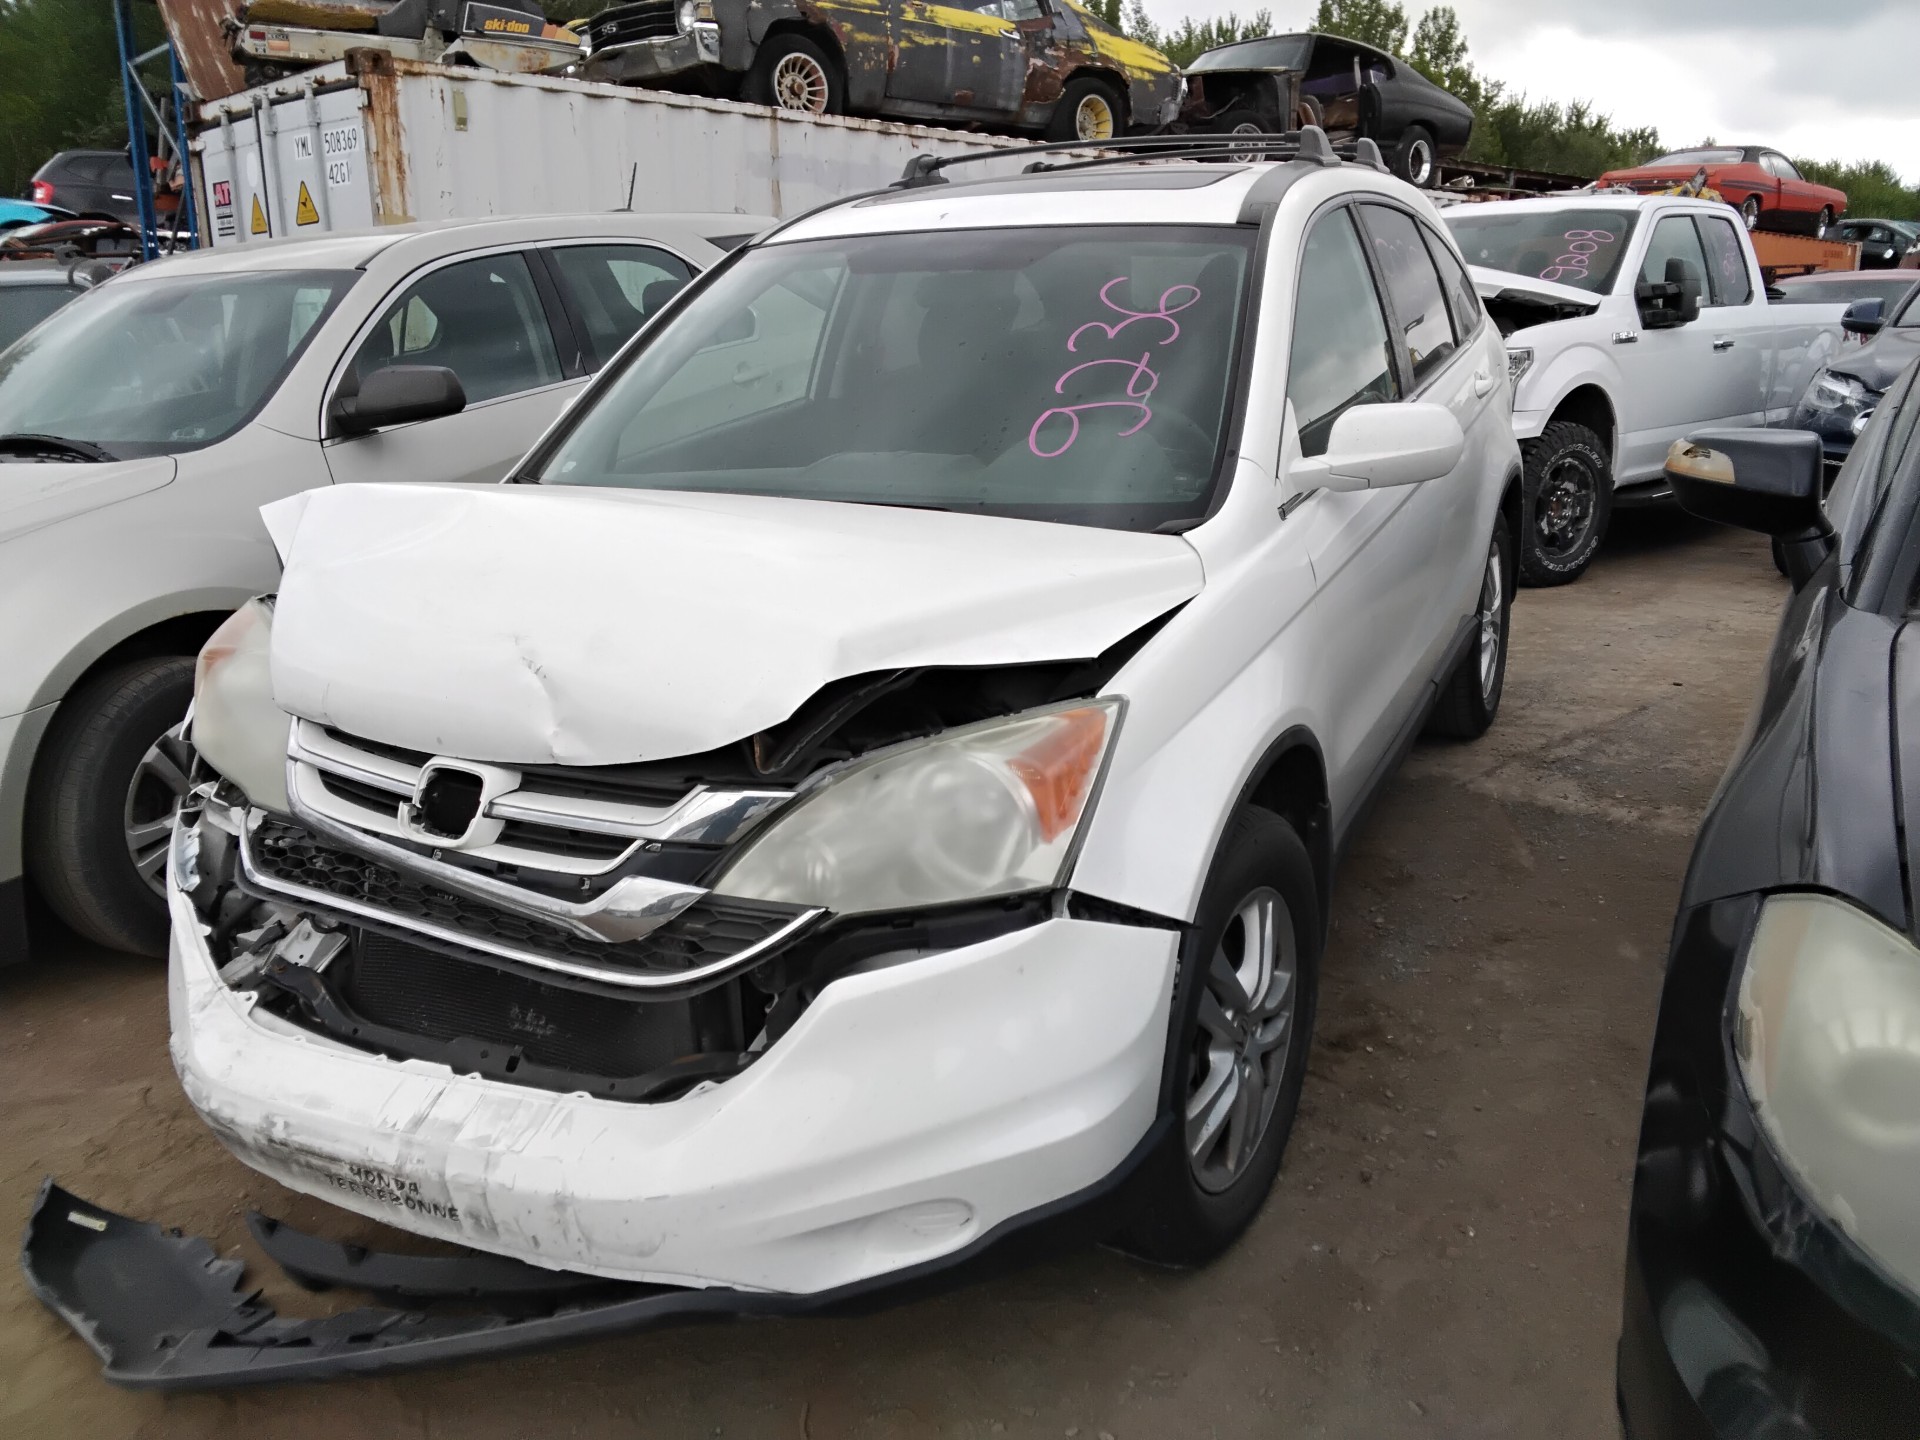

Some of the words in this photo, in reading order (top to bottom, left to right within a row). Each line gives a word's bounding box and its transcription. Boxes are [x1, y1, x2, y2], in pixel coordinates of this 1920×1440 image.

[484, 18, 530, 33] ski-doo
[295, 136, 312, 157] YML
[324, 128, 357, 154] 508369
[329, 161, 350, 184] 42G1
[1540, 230, 1614, 280] 9208
[1029, 276, 1200, 457] 9236
[349, 1166, 419, 1195] HONDA
